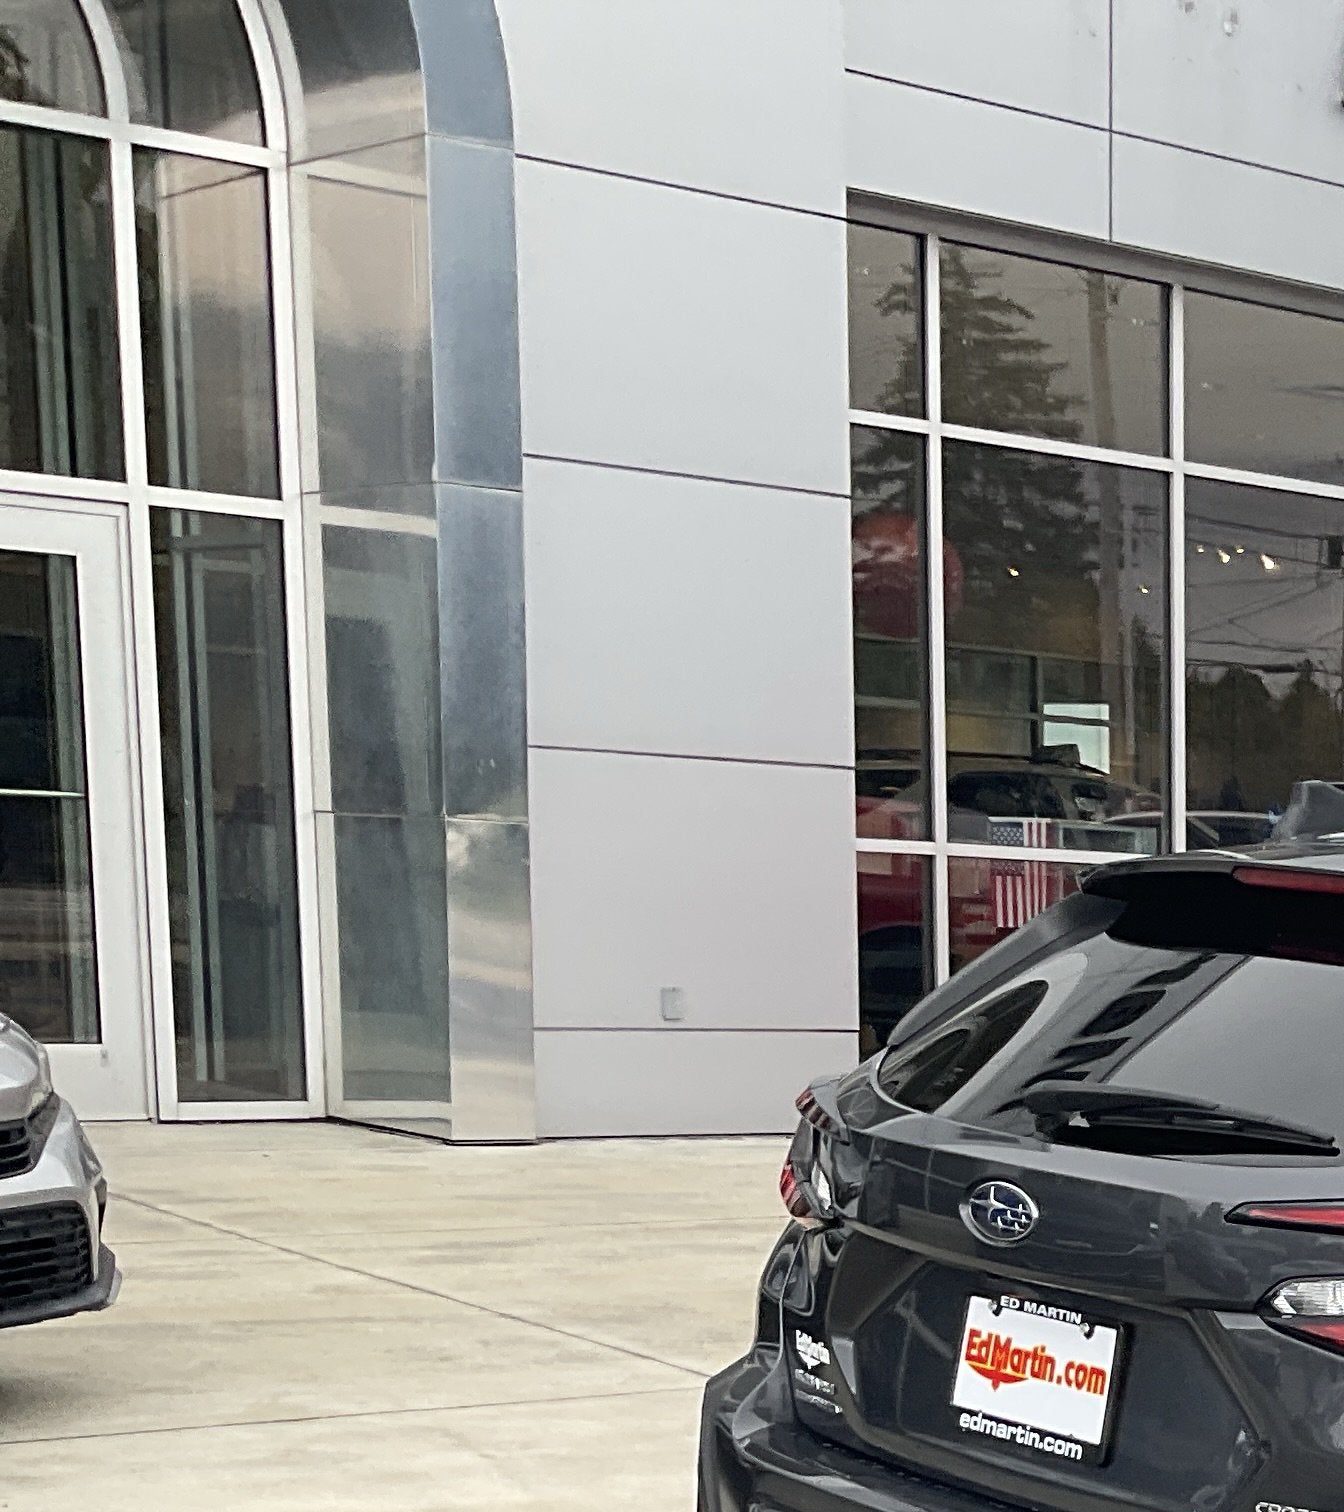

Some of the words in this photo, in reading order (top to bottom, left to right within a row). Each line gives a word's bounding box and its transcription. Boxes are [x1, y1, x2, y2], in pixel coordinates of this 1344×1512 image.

[1000, 1296, 1019, 1309] ED
[1023, 1301, 1082, 1325] MARTIN
[965, 1328, 1107, 1396] EdMartin.com
[959, 1412, 1083, 1460] edmartin.com
